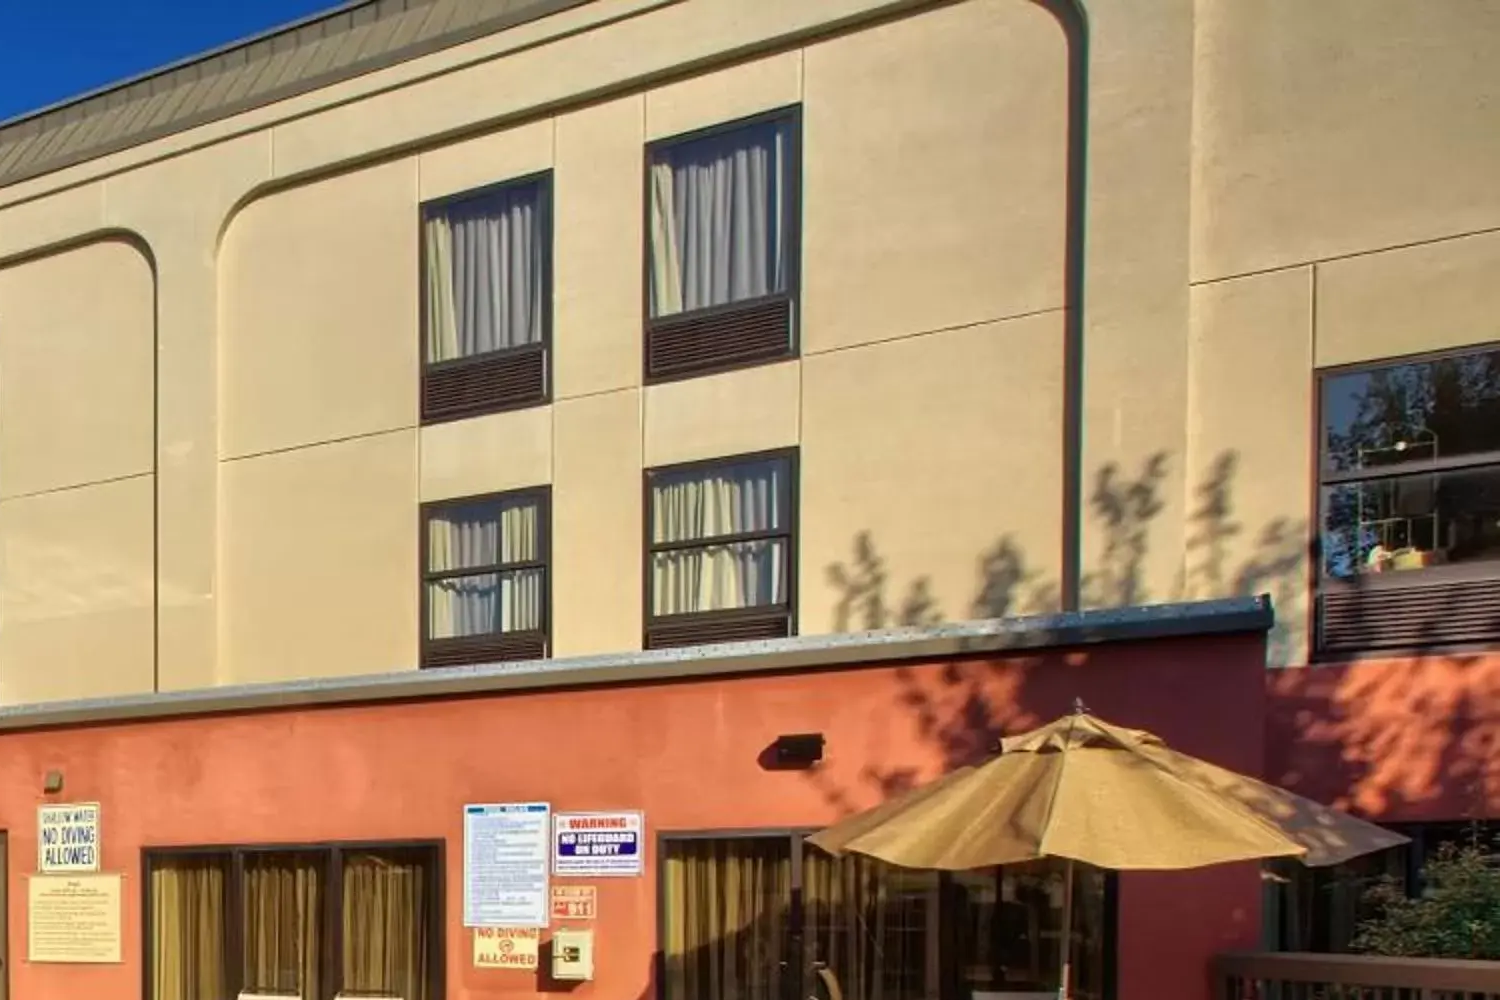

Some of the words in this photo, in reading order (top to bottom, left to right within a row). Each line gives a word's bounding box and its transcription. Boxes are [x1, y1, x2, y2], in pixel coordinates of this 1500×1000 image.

[570, 817, 627, 829] WARNING
[43, 827, 58, 845] NO
[61, 825, 95, 845] DIVING
[561, 833, 576, 844] NO
[578, 831, 635, 844] LIFEGUARD
[575, 844, 590, 855] ON
[591, 843, 621, 855] DUTY
[45, 846, 95, 866] ALLOWED
[477, 927, 494, 938] NO
[498, 927, 537, 939] DIVING
[477, 952, 535, 965] ALLOWED
